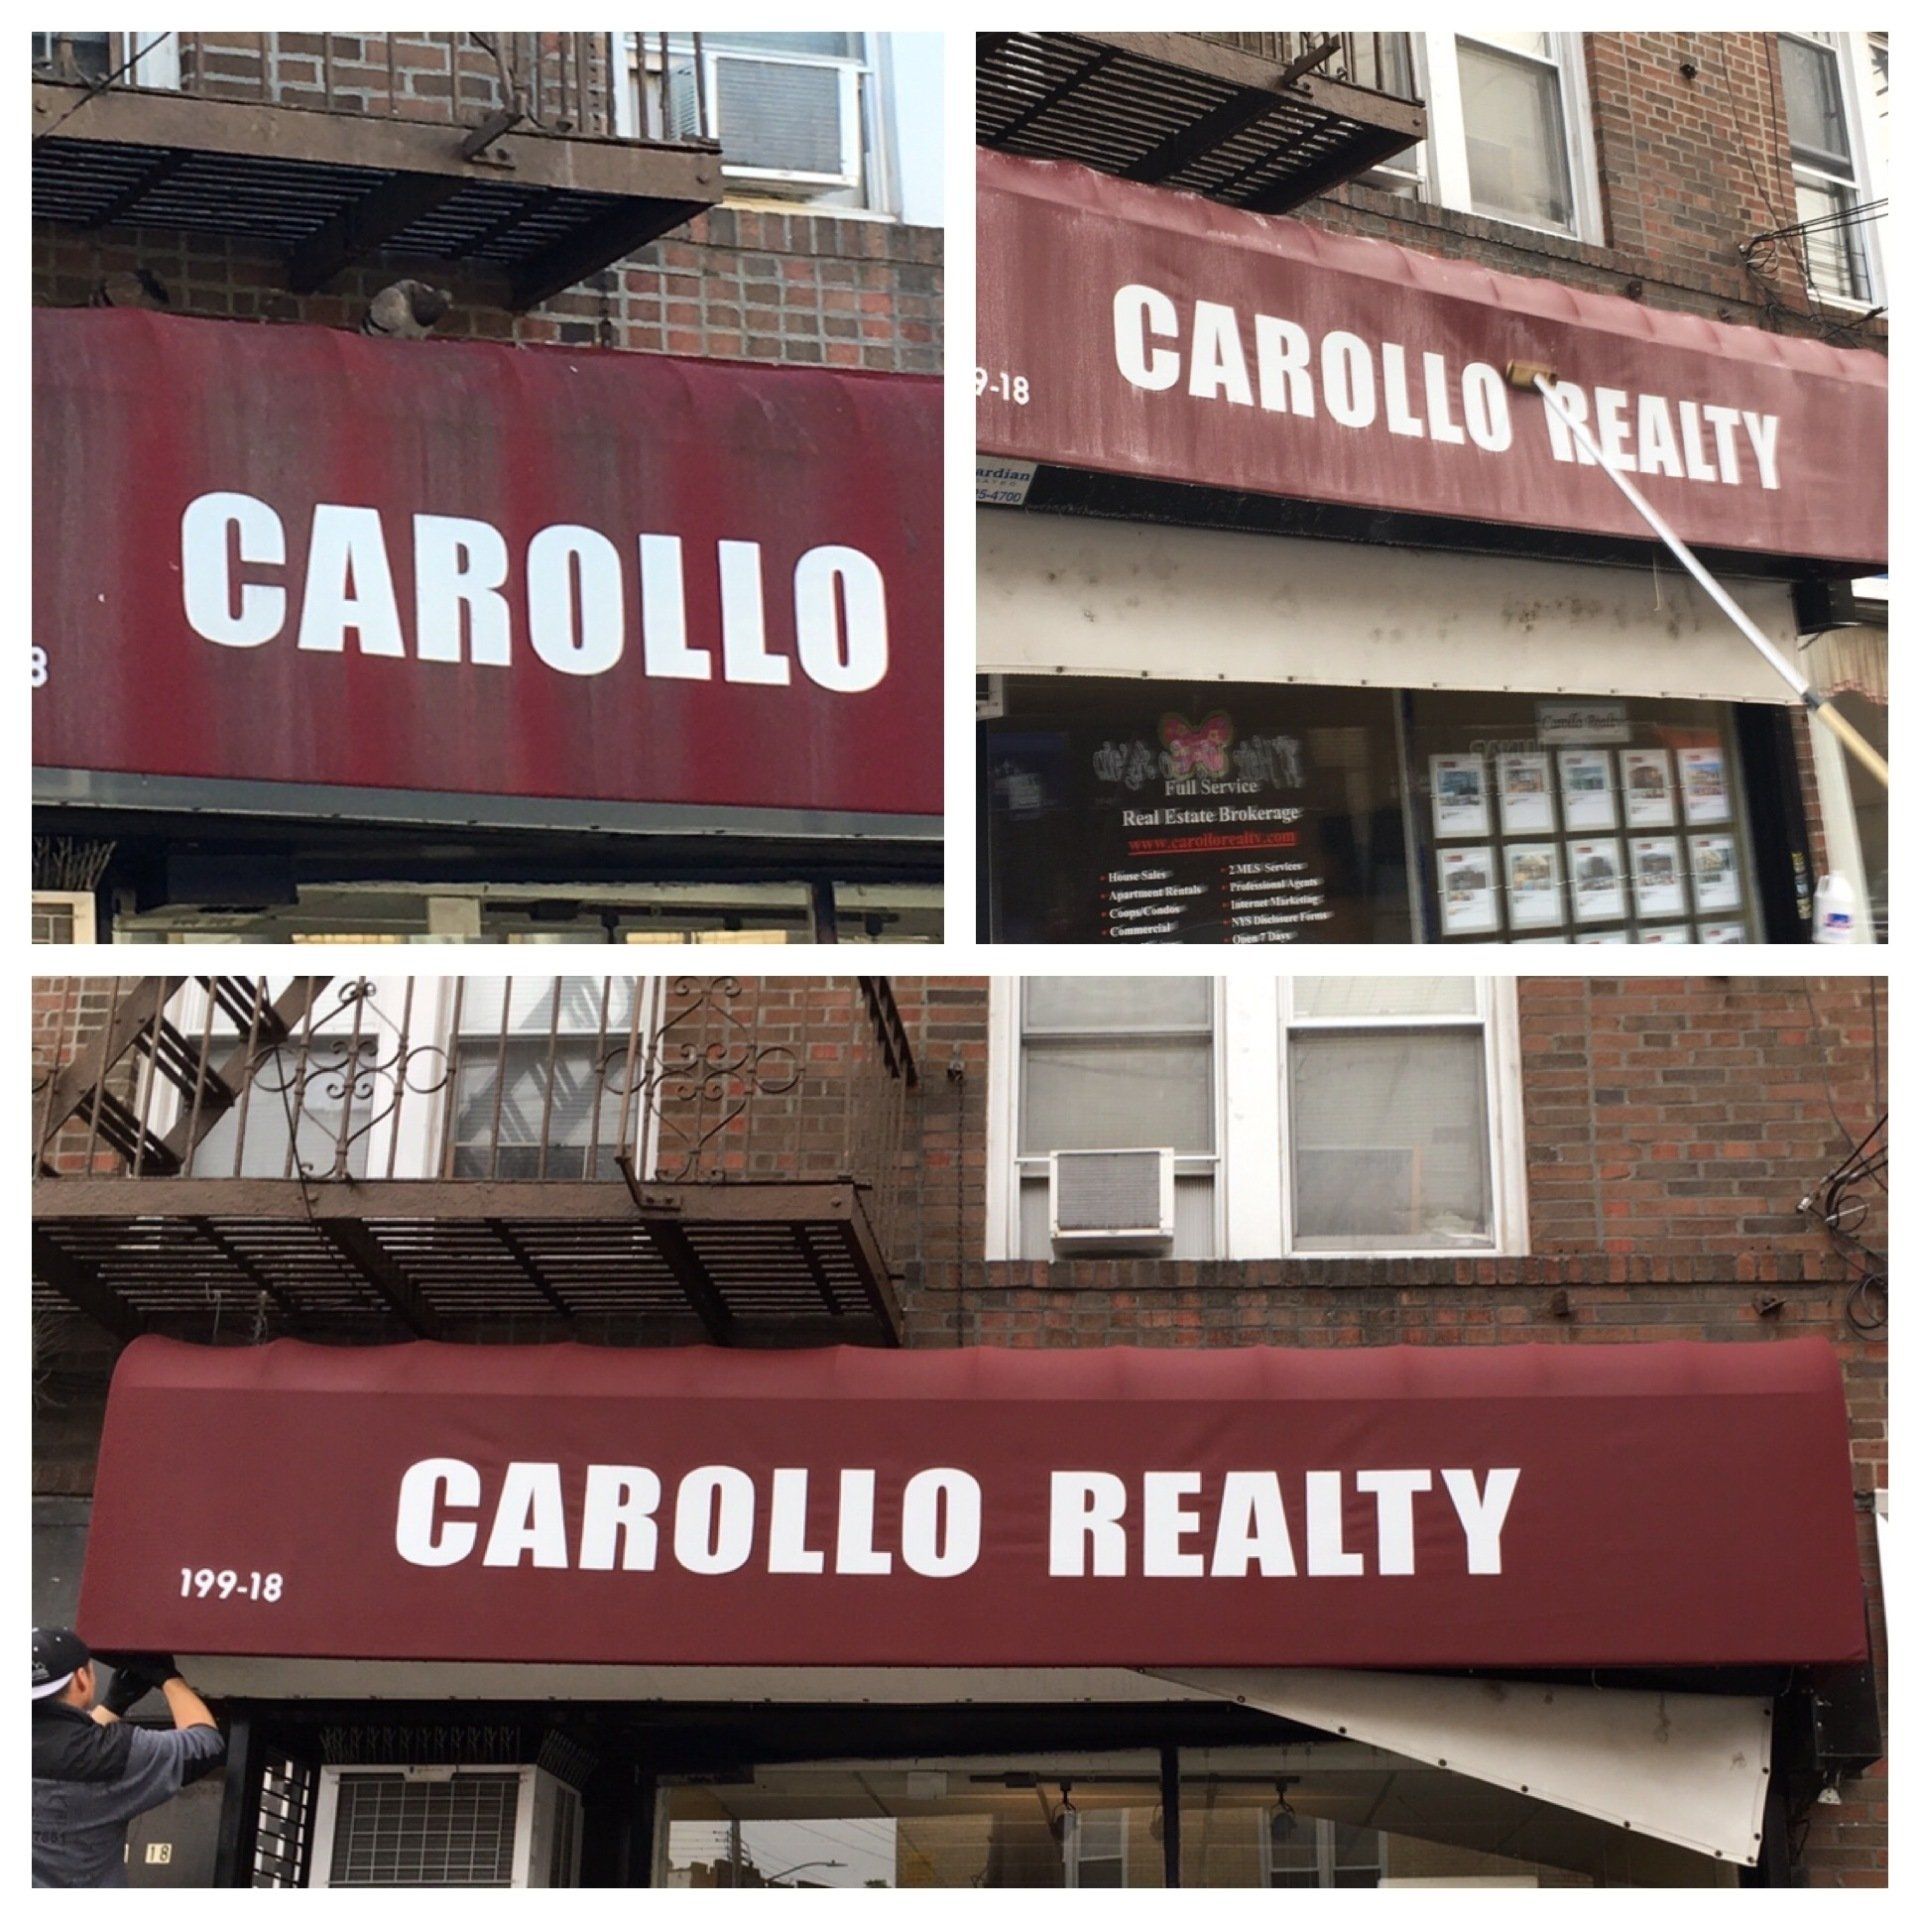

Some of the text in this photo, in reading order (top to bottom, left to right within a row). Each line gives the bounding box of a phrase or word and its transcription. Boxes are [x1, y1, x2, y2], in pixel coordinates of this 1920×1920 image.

[976, 366, 1030, 406] 9-18
[1113, 283, 1781, 491] CAROLLO REALTY
[976, 489, 1022, 502] 5-4700
[181, 491, 889, 693] CAROLLO
[1165, 778, 1259, 796] Full Service
[1123, 804, 1300, 826] Real Estate Brokerage
[1109, 884, 1201, 903] Apartment Rentals
[1110, 922, 1171, 938] Commercial
[396, 1457, 1522, 1578] CAROLLO REALTY
[181, 1567, 284, 1602] 199-18
[149, 1845, 170, 1862] 18
